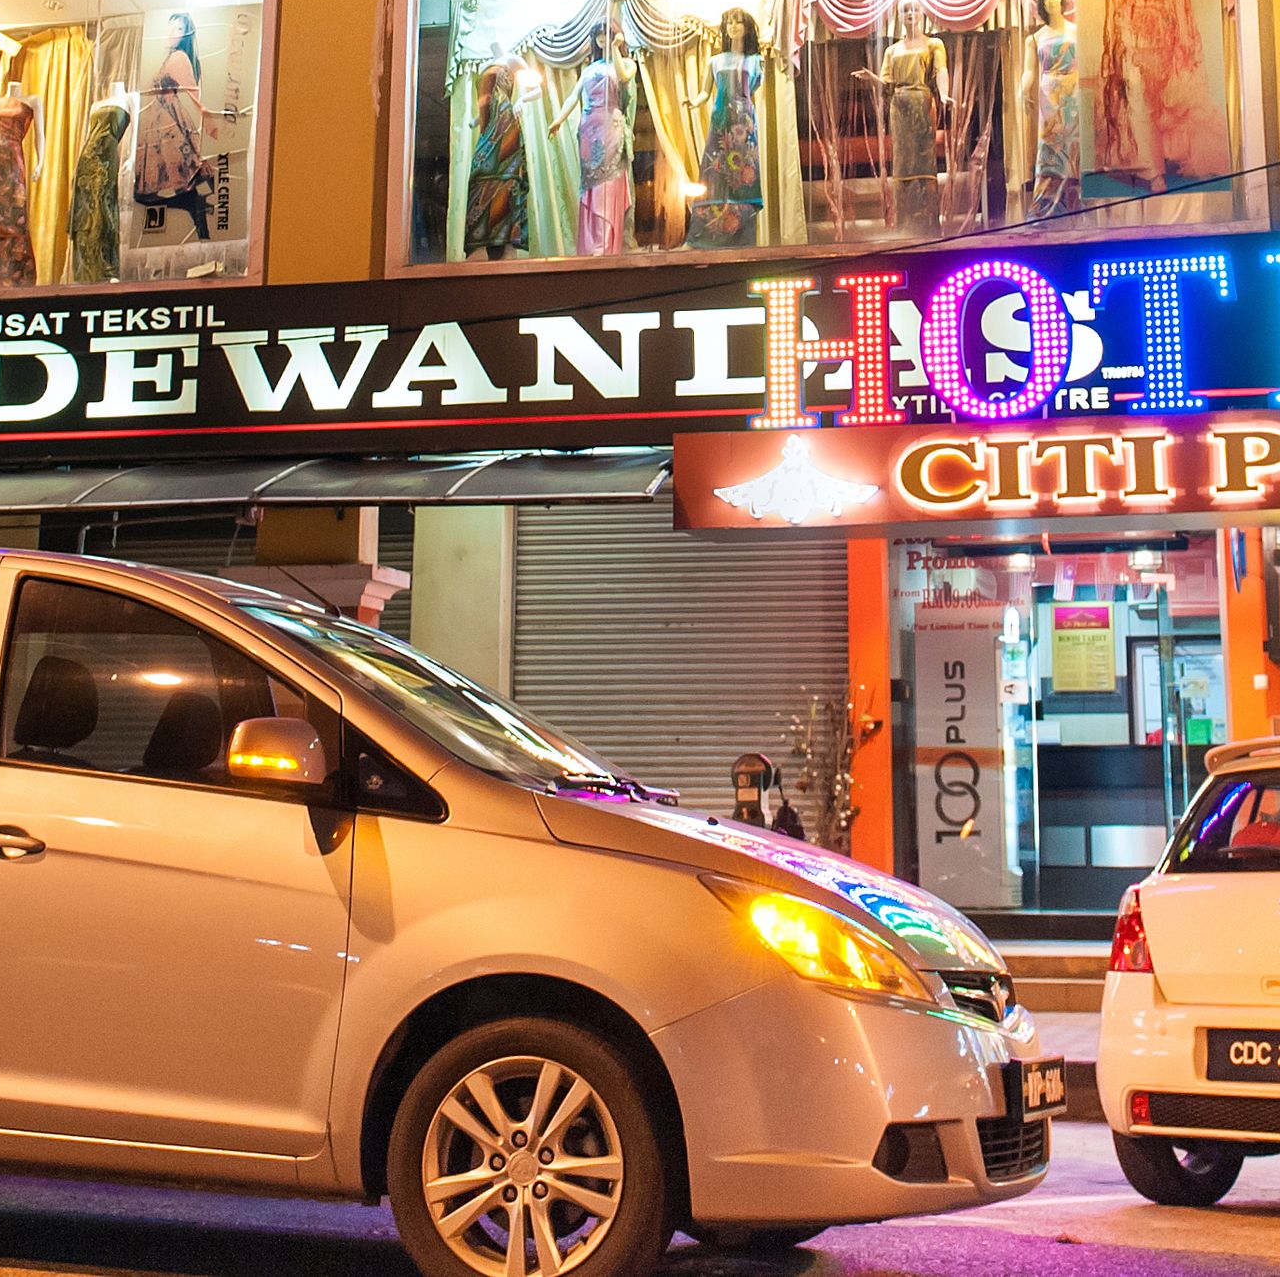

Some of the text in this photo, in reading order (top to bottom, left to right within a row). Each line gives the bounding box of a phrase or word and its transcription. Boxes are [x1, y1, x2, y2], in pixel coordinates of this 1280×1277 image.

[217, 186, 230, 231] CENTRE
[82, 305, 226, 334] TEKSTIL
[894, 433, 1177, 515] CITI
[1229, 1040, 1272, 1066] CDC
